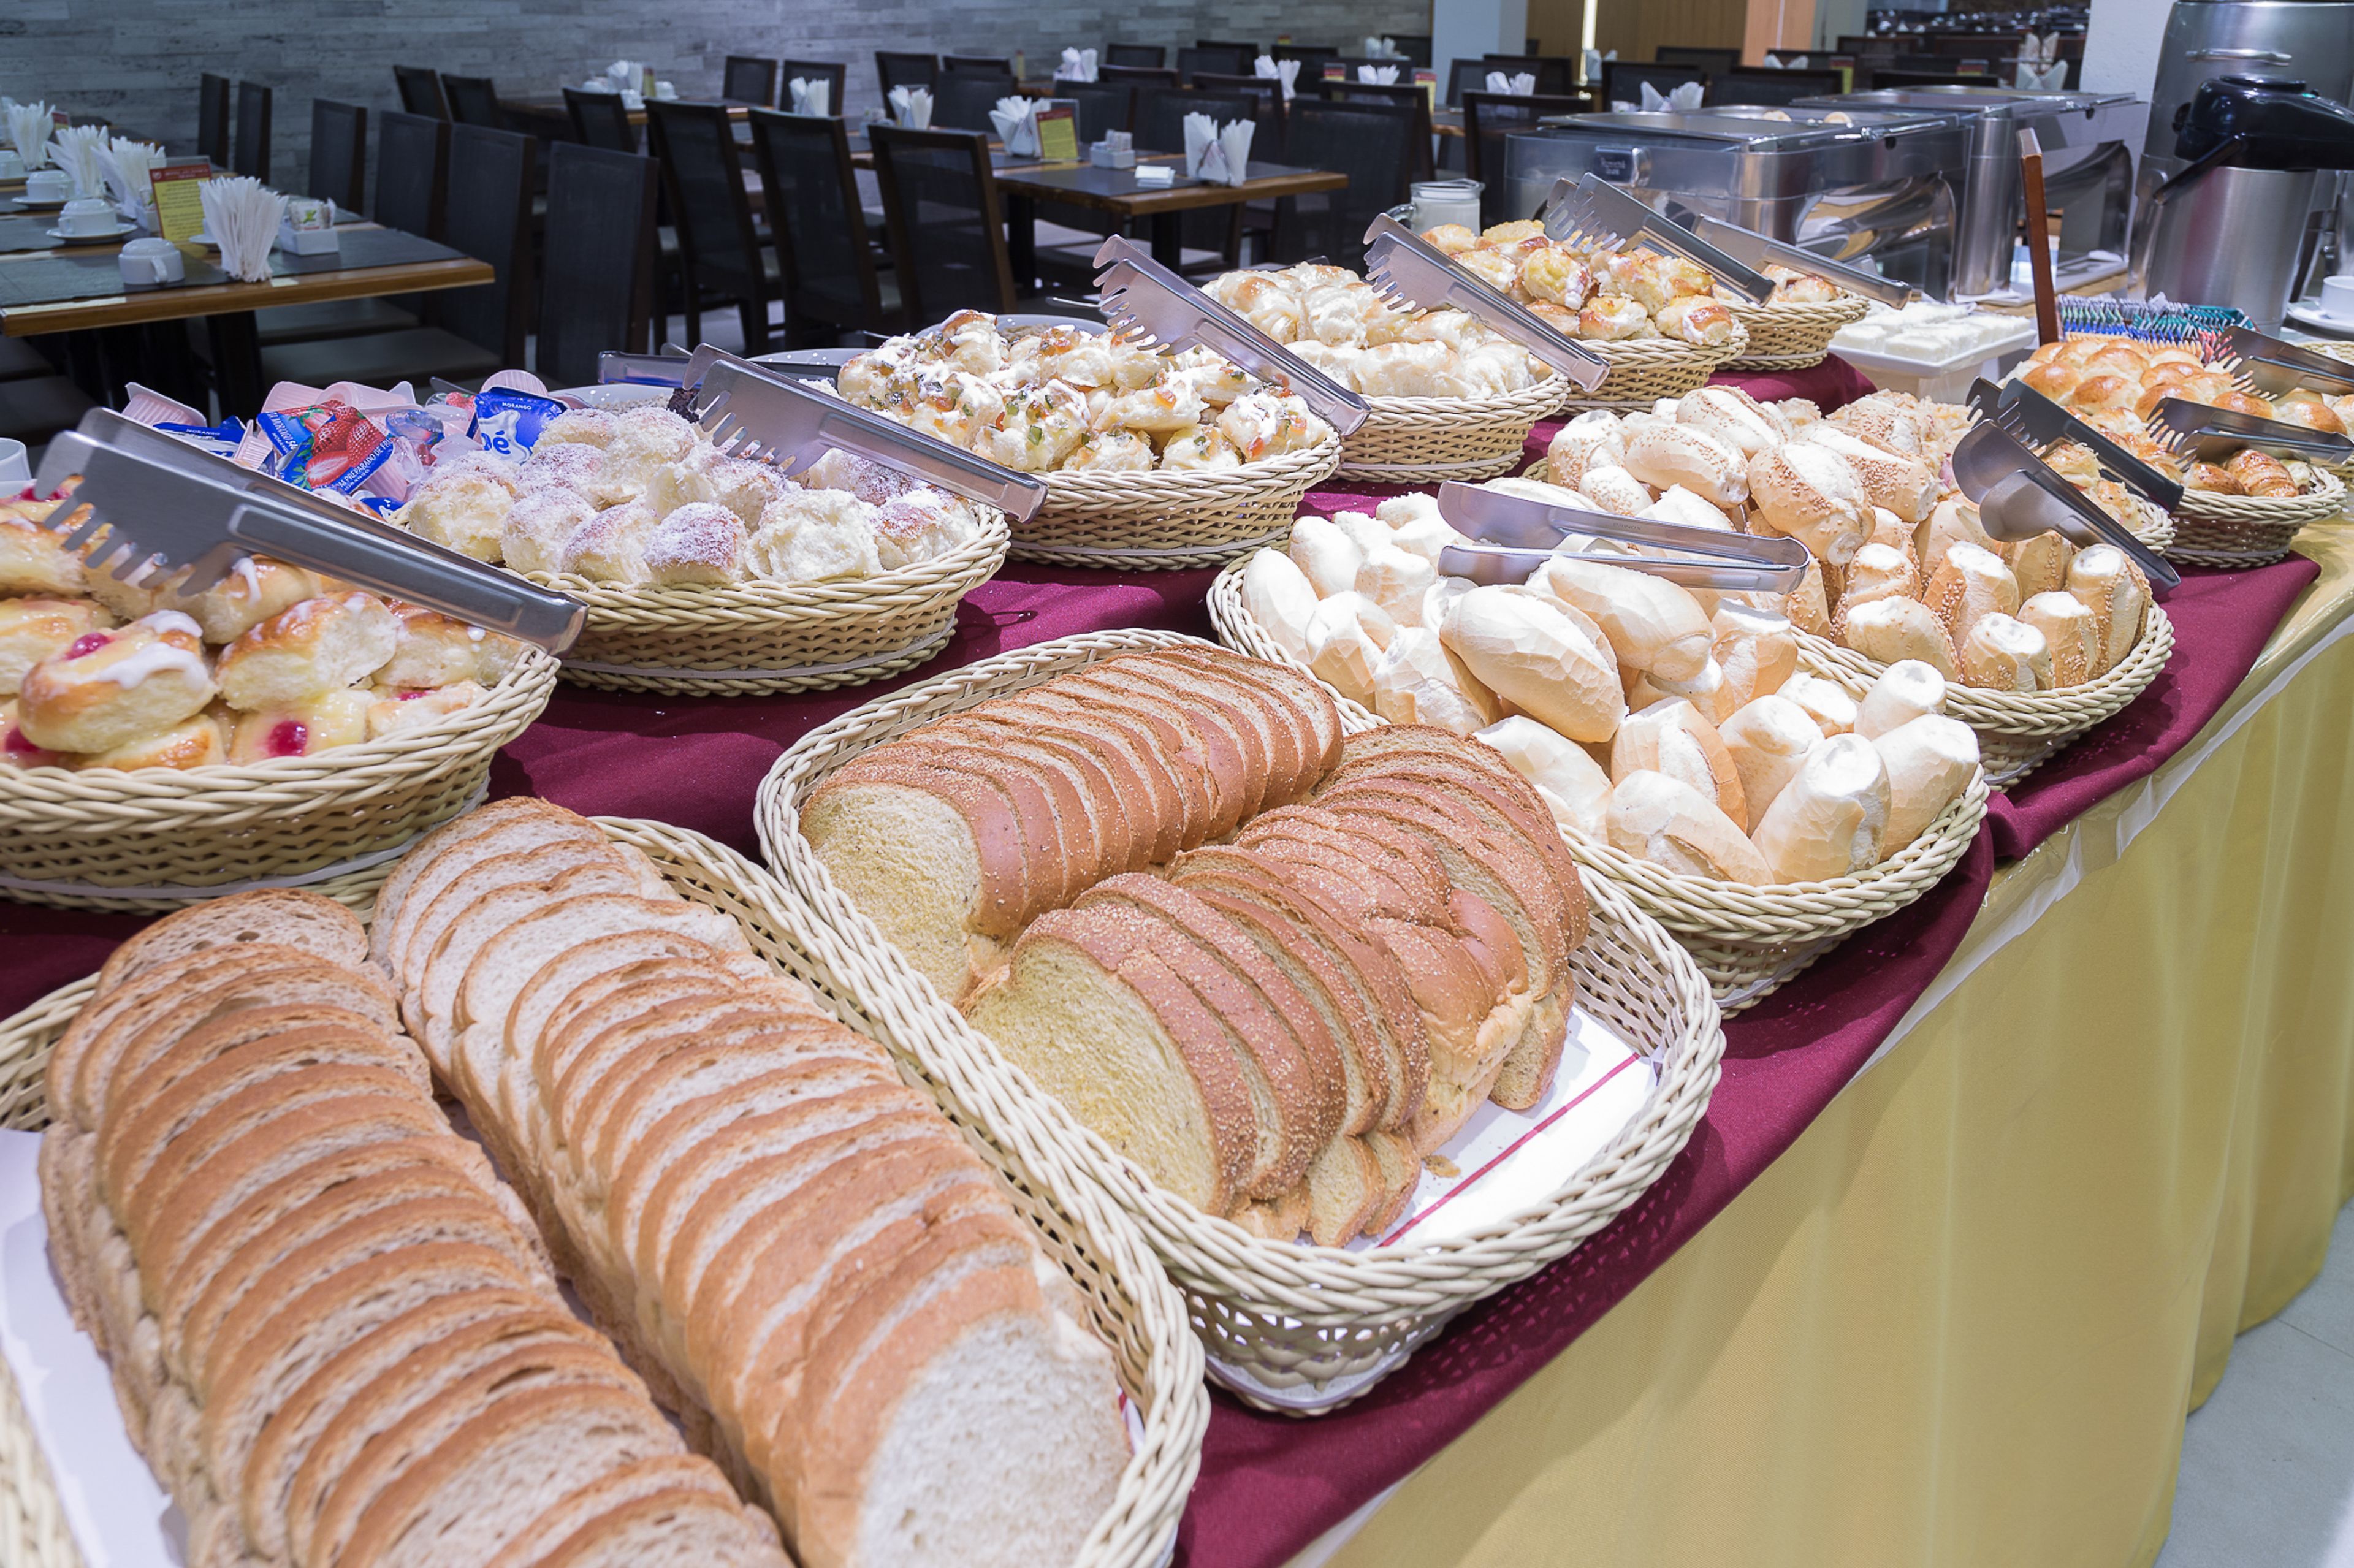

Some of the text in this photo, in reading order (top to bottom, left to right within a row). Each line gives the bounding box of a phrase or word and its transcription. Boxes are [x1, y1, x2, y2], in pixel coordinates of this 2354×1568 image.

[502, 402, 531, 410] MORANGO
[345, 454, 376, 482] PREPARADO
[373, 446, 384, 457] DE
